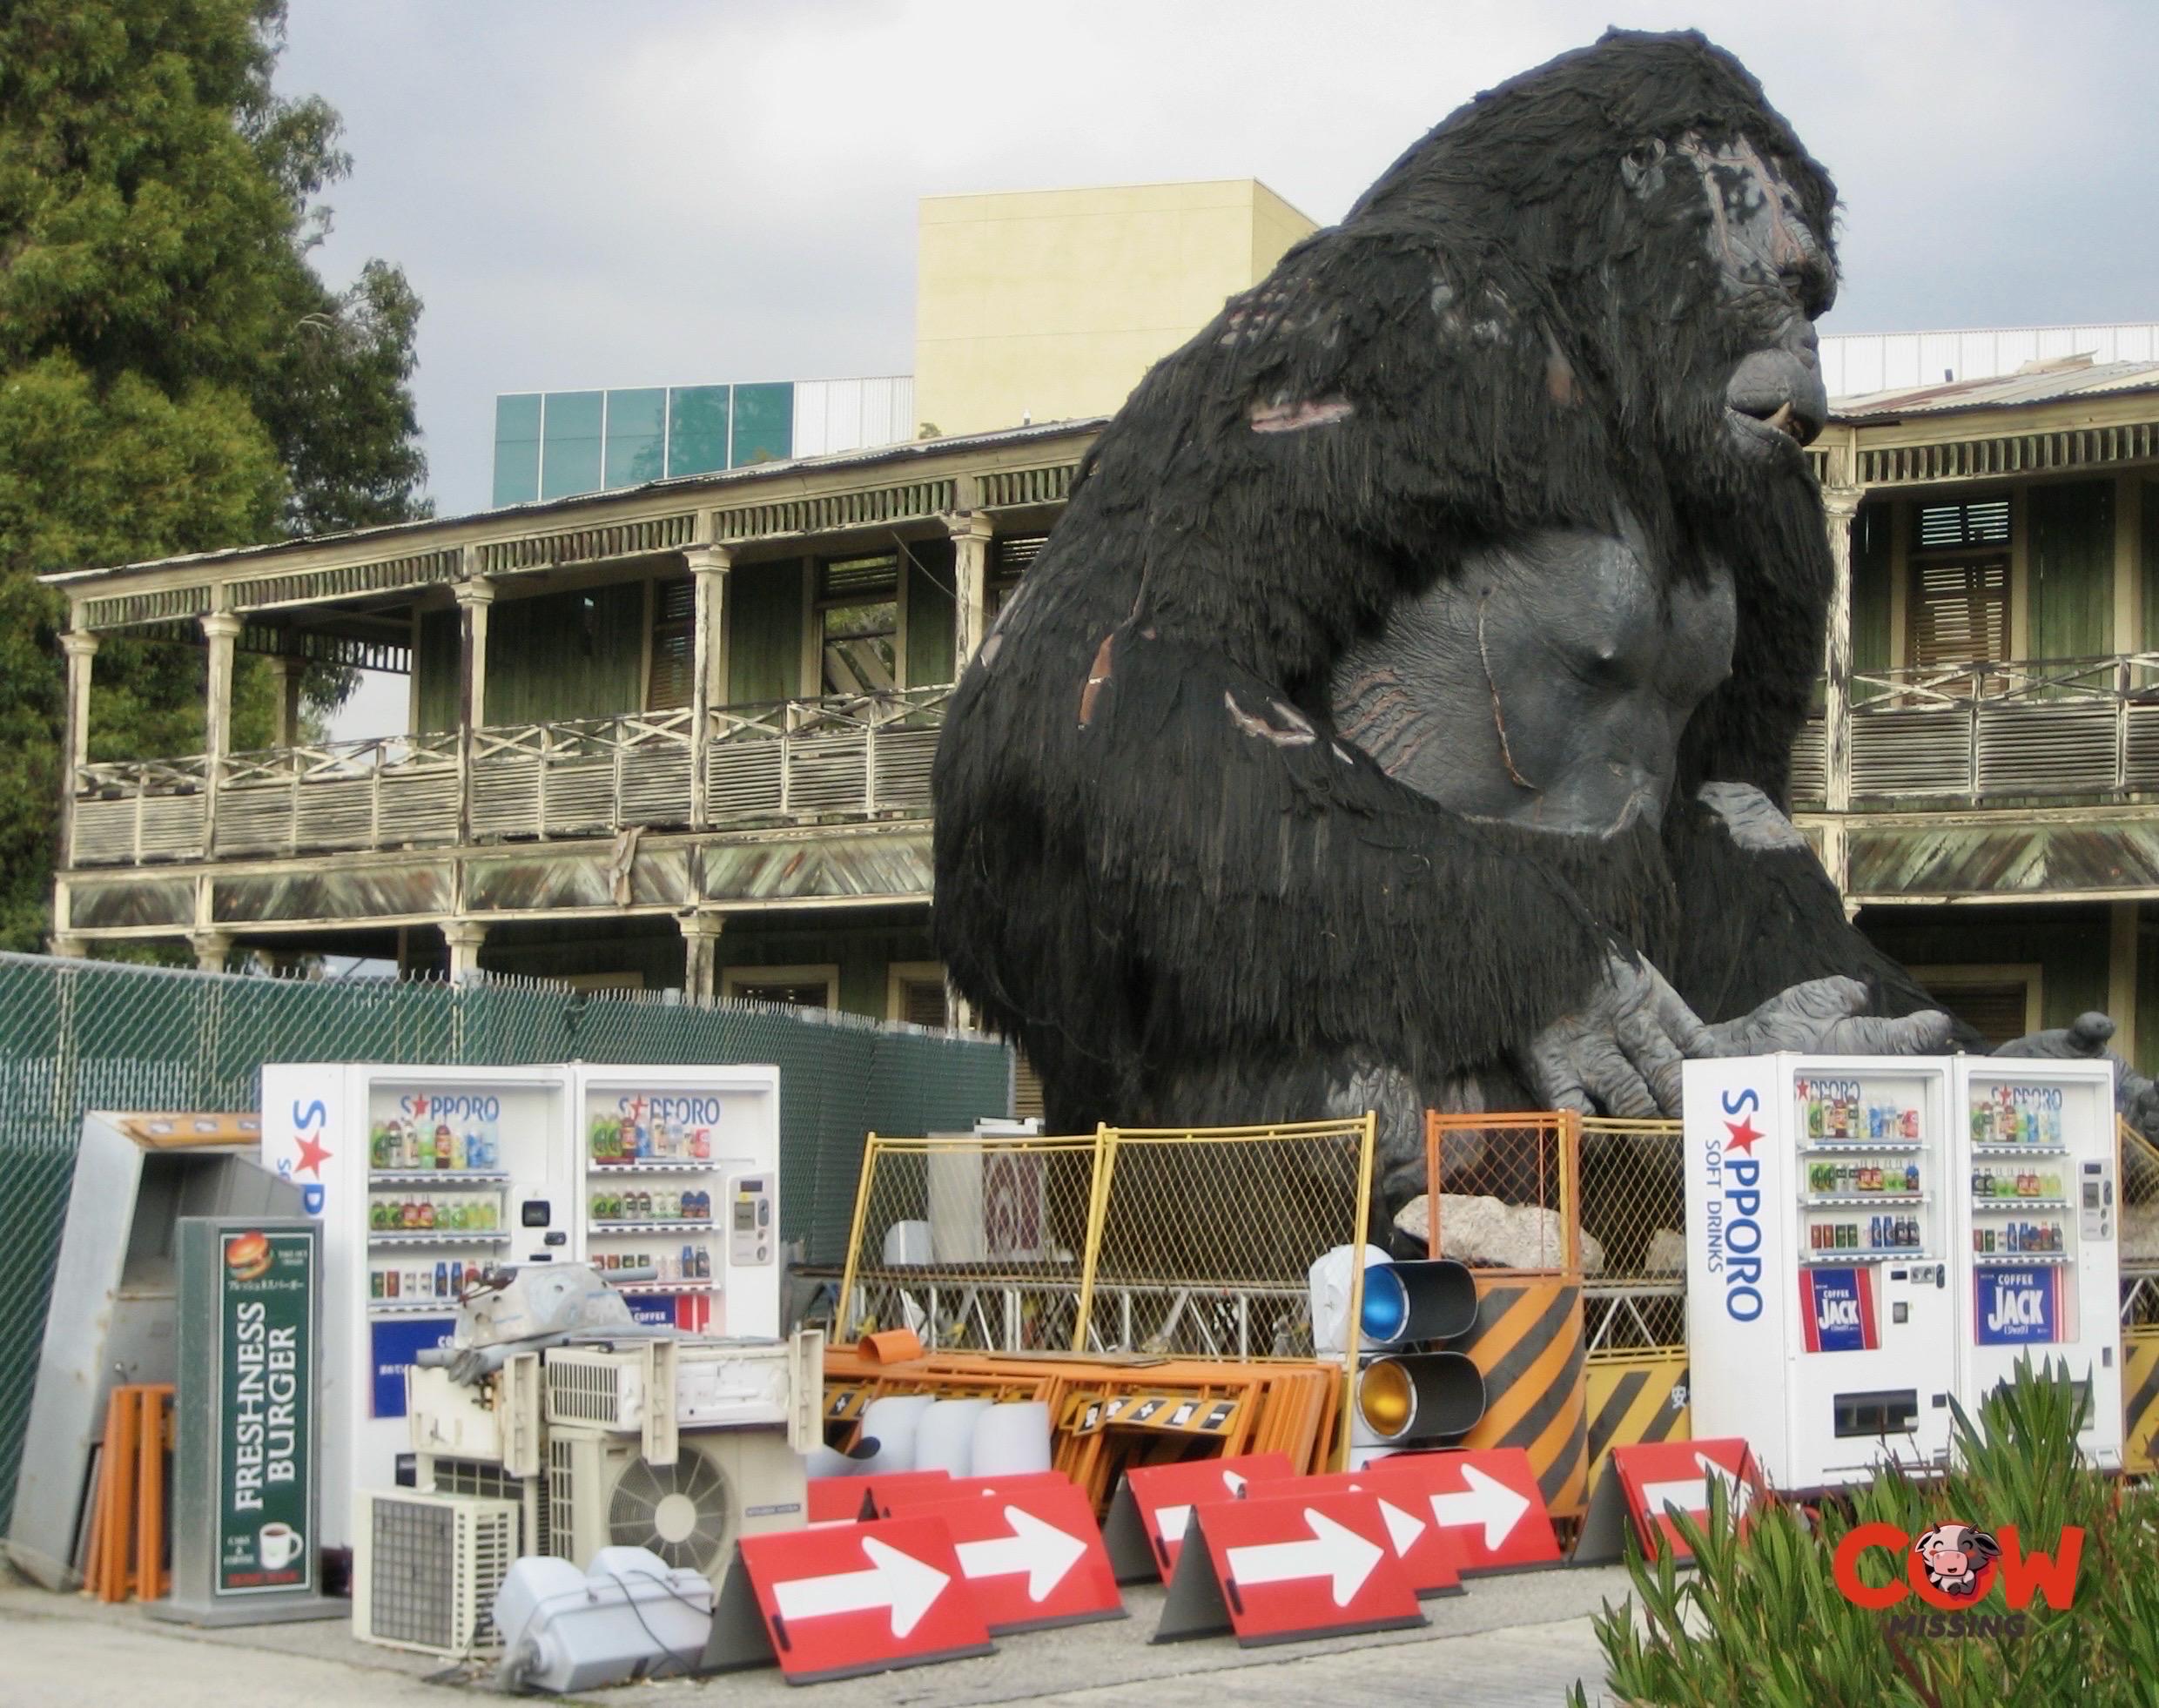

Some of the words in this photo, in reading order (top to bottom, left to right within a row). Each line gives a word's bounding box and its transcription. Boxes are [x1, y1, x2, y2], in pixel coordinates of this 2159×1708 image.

[1705, 1140, 1721, 1187] SOFT
[1707, 1201, 1723, 1273] DRINKS
[1998, 1274, 2034, 1285] COFFEE
[1819, 1299, 1860, 1329] JACK
[1987, 1286, 2044, 1331] JACK
[235, 1301, 266, 1510] FRESHNESS
[267, 1325, 297, 1482] BURGER
